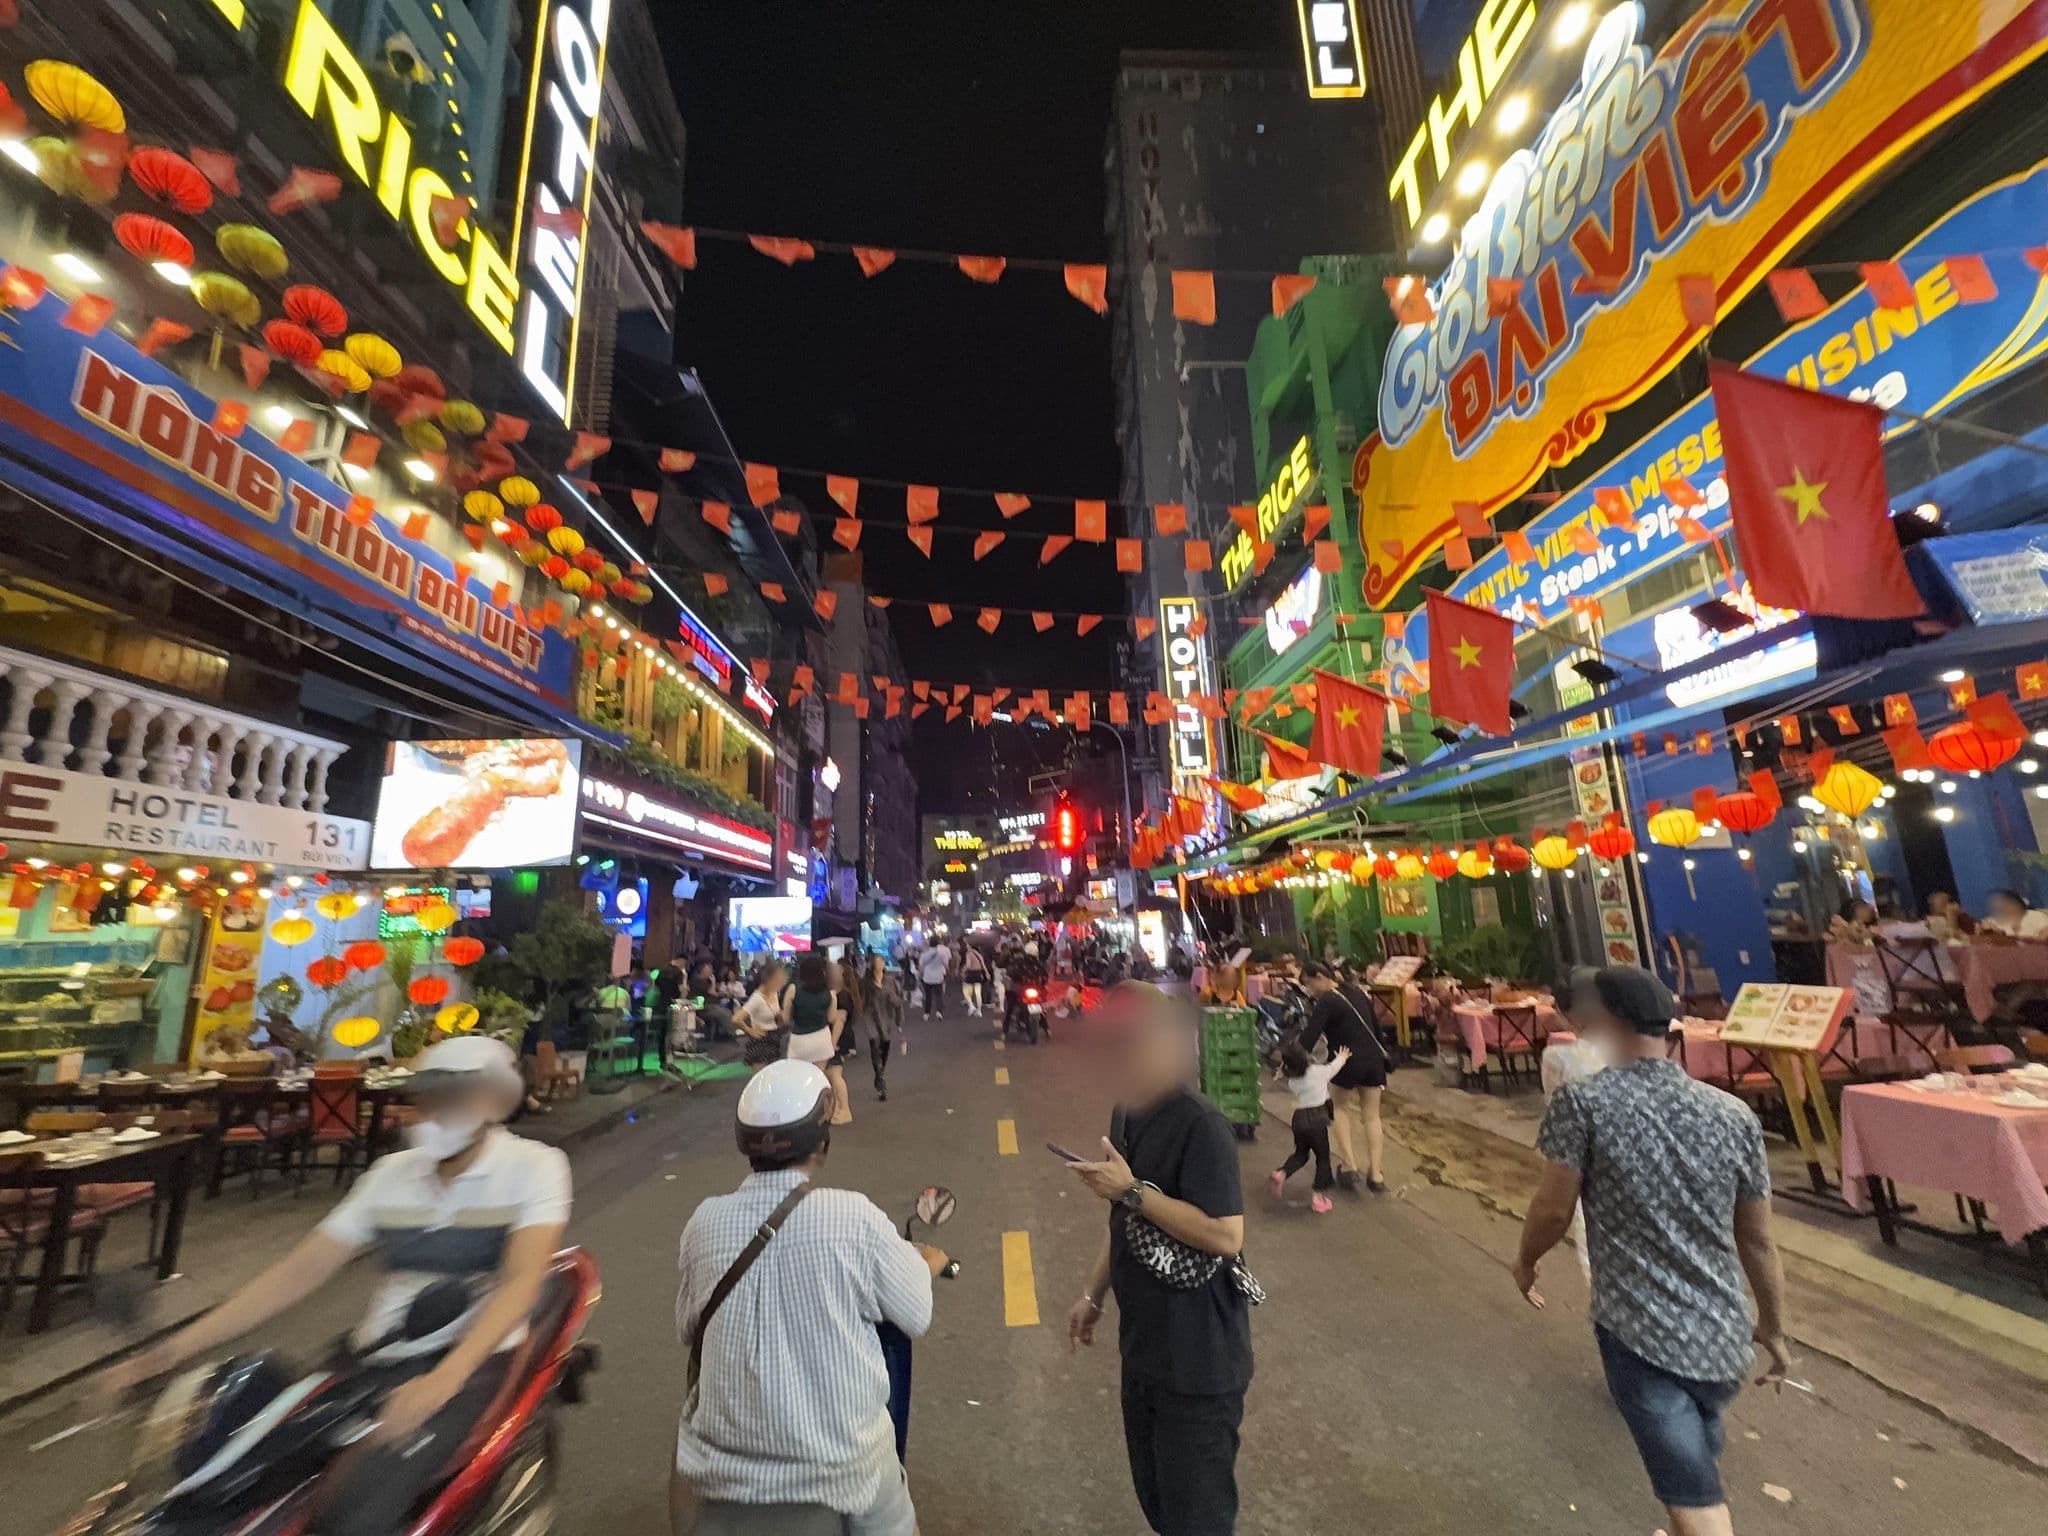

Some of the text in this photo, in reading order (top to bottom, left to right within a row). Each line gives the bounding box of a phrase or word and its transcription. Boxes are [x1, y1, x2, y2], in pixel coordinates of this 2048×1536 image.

[1389, 0, 1536, 230] THE
[285, 0, 519, 356] RICE
[1449, 0, 1841, 448] ĐẠI VIỆT
[71, 345, 284, 522] NÔNG
[289, 478, 414, 599] THÔN
[1221, 529, 1254, 591] THE
[1258, 435, 1310, 544] RICE
[1464, 562, 1530, 609] ENTIC
[1540, 544, 1616, 606] Steak
[1167, 605, 1203, 767] HOTEL
[106, 822, 279, 858] RESTAURANT
[109, 787, 238, 829] HOTEL
[305, 821, 356, 851] 131
[1149, 1246, 1176, 1275] NY
